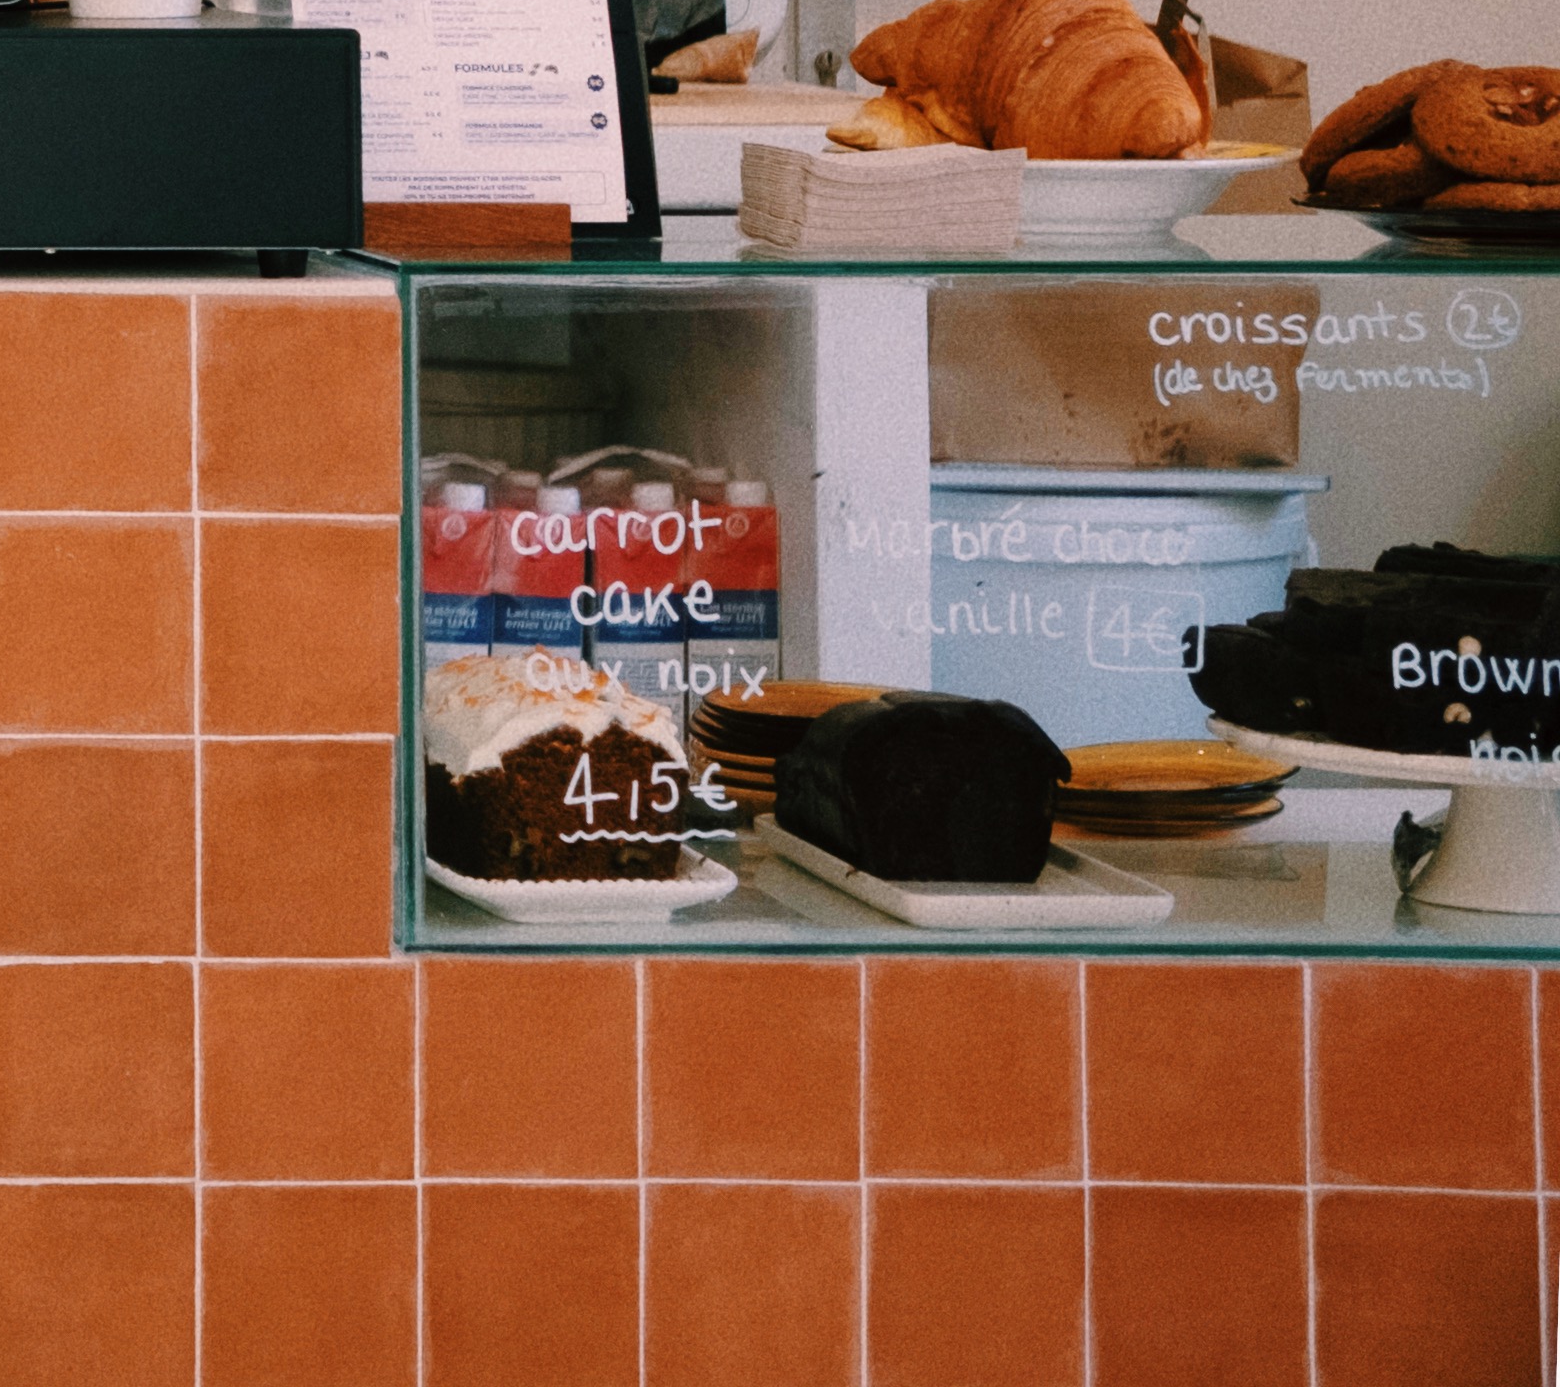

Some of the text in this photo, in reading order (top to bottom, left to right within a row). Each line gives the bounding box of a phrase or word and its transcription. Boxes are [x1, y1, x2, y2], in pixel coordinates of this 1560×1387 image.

[454, 63, 525, 74] FORMULES
[1148, 301, 1427, 347] croissants
[1212, 361, 1278, 404] chez
[510, 498, 723, 557] carrot
[1053, 520, 1195, 566] choco
[569, 579, 722, 627] cake
[525, 648, 769, 703] aux noix
